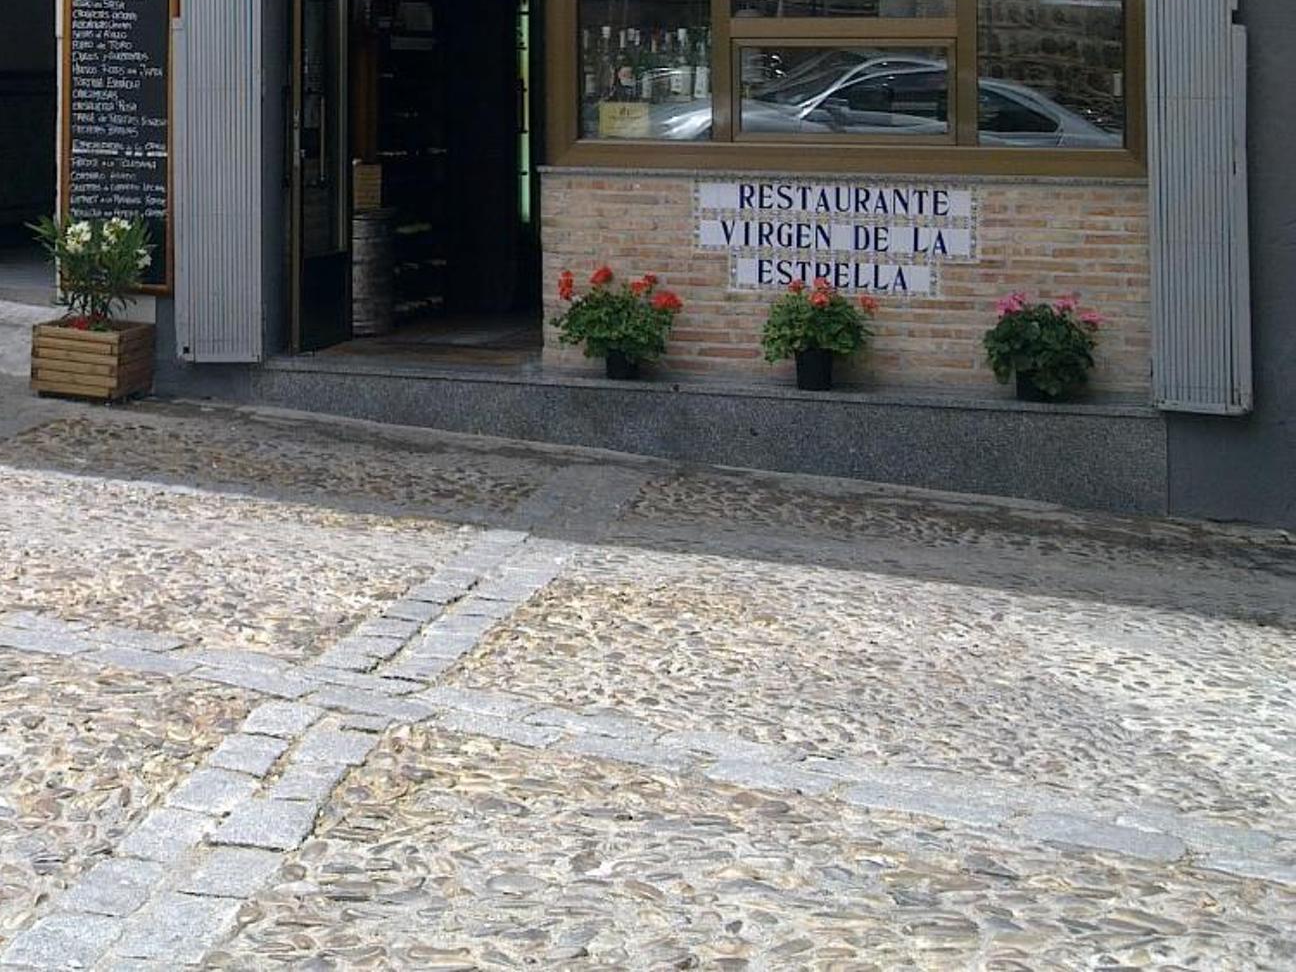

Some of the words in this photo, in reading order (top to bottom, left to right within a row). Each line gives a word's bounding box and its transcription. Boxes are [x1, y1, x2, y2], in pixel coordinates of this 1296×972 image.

[740, 184, 950, 217] RESTAURANTE
[721, 220, 832, 249] VIRGEN
[855, 225, 890, 252] DE
[913, 228, 947, 255] LA
[759, 259, 908, 290] ESTRELLA
